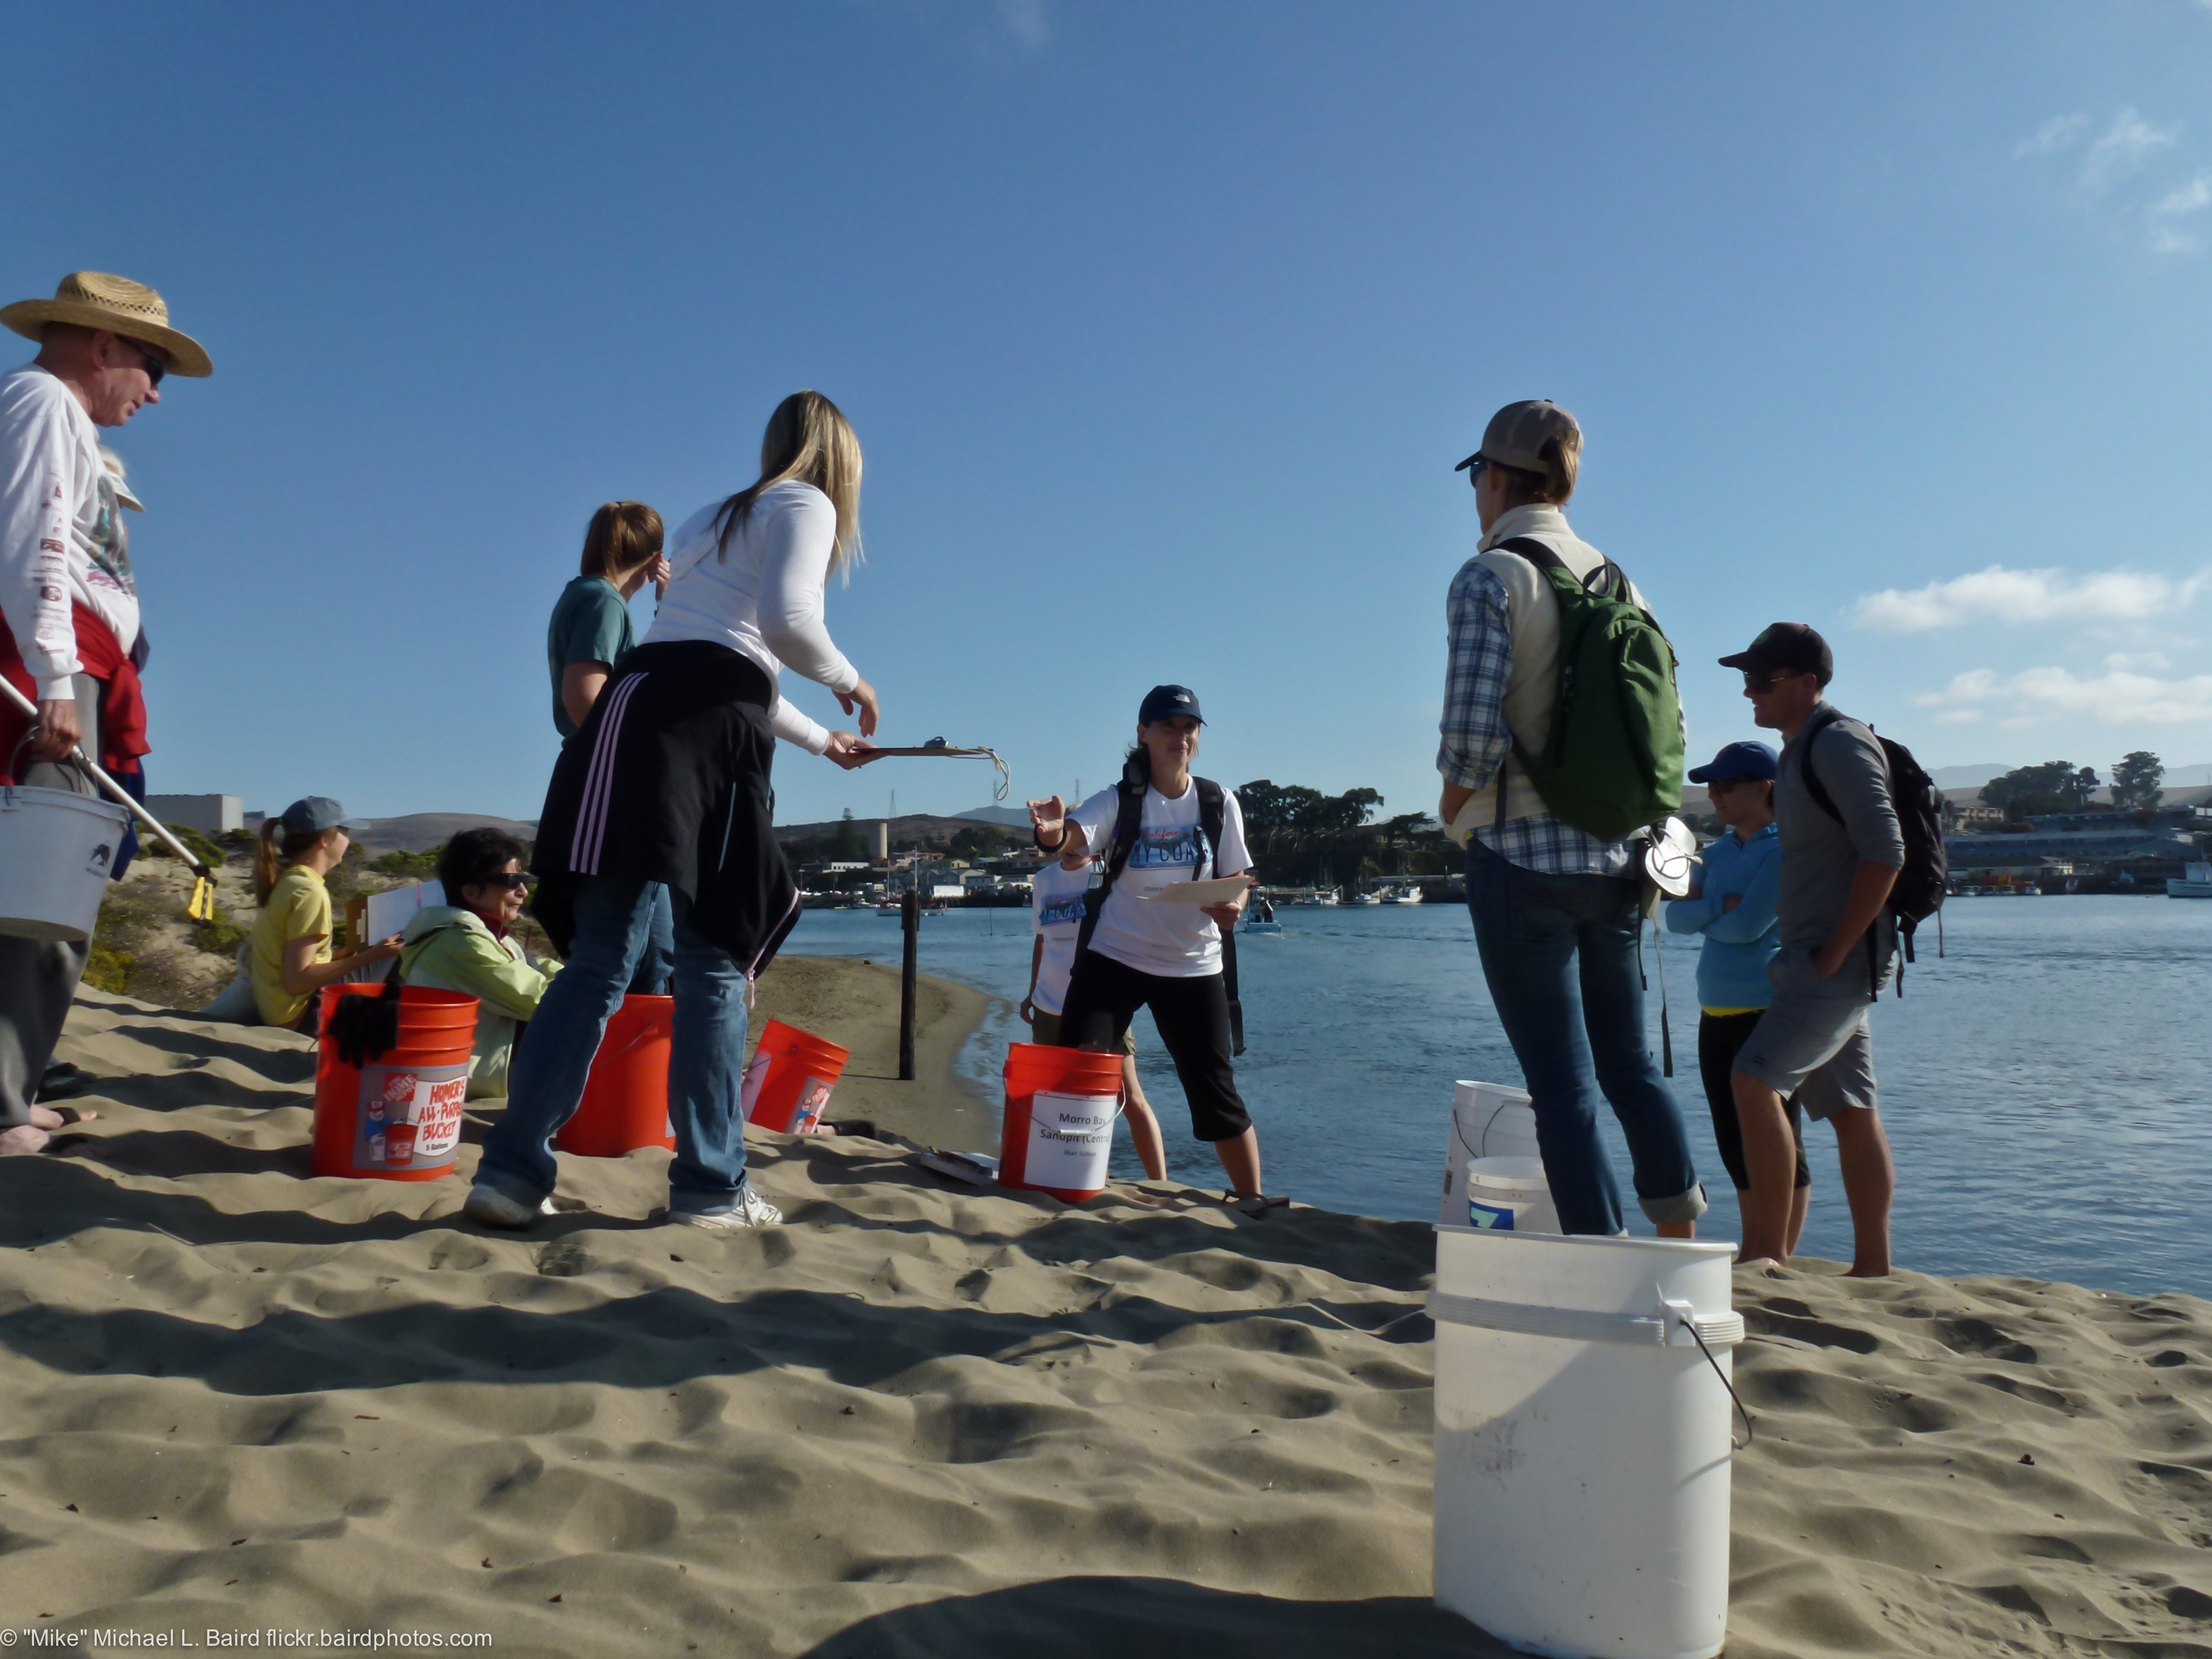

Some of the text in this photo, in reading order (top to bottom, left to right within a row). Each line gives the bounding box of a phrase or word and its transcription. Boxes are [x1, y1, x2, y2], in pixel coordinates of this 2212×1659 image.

[1159, 841, 1208, 862] COA
[1059, 1113, 1107, 1125] Morro Bay
[423, 1120, 457, 1142] BUCKET
